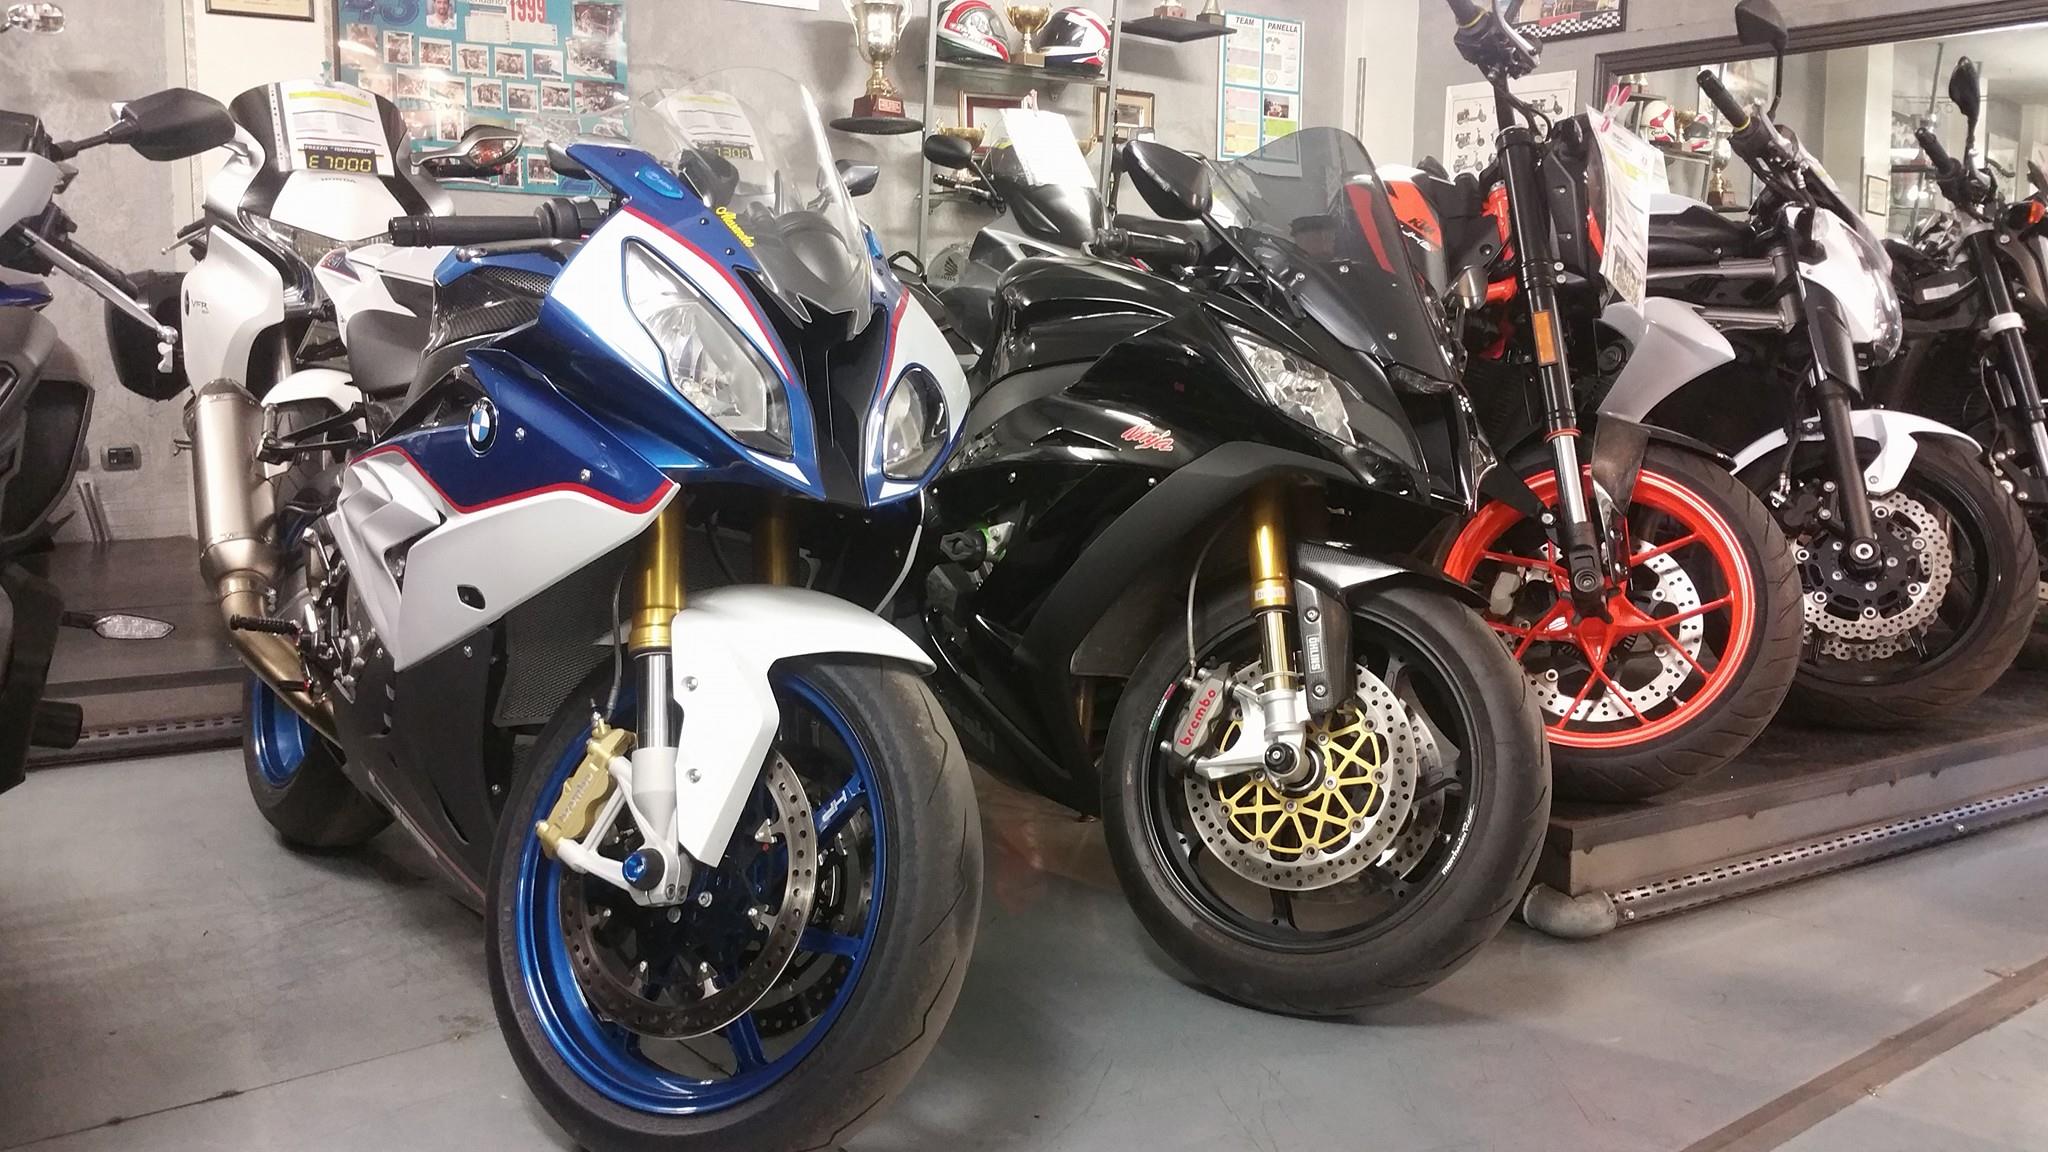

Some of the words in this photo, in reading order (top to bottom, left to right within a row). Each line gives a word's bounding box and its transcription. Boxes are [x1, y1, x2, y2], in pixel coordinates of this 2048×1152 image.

[510, 0, 545, 23] 1999
[1235, 16, 1255, 26] TEAM
[1267, 22, 1298, 33] PANELLA
[324, 155, 372, 172] 7000
[1121, 424, 1174, 451] Ninja
[1180, 689, 1216, 746] brembo
